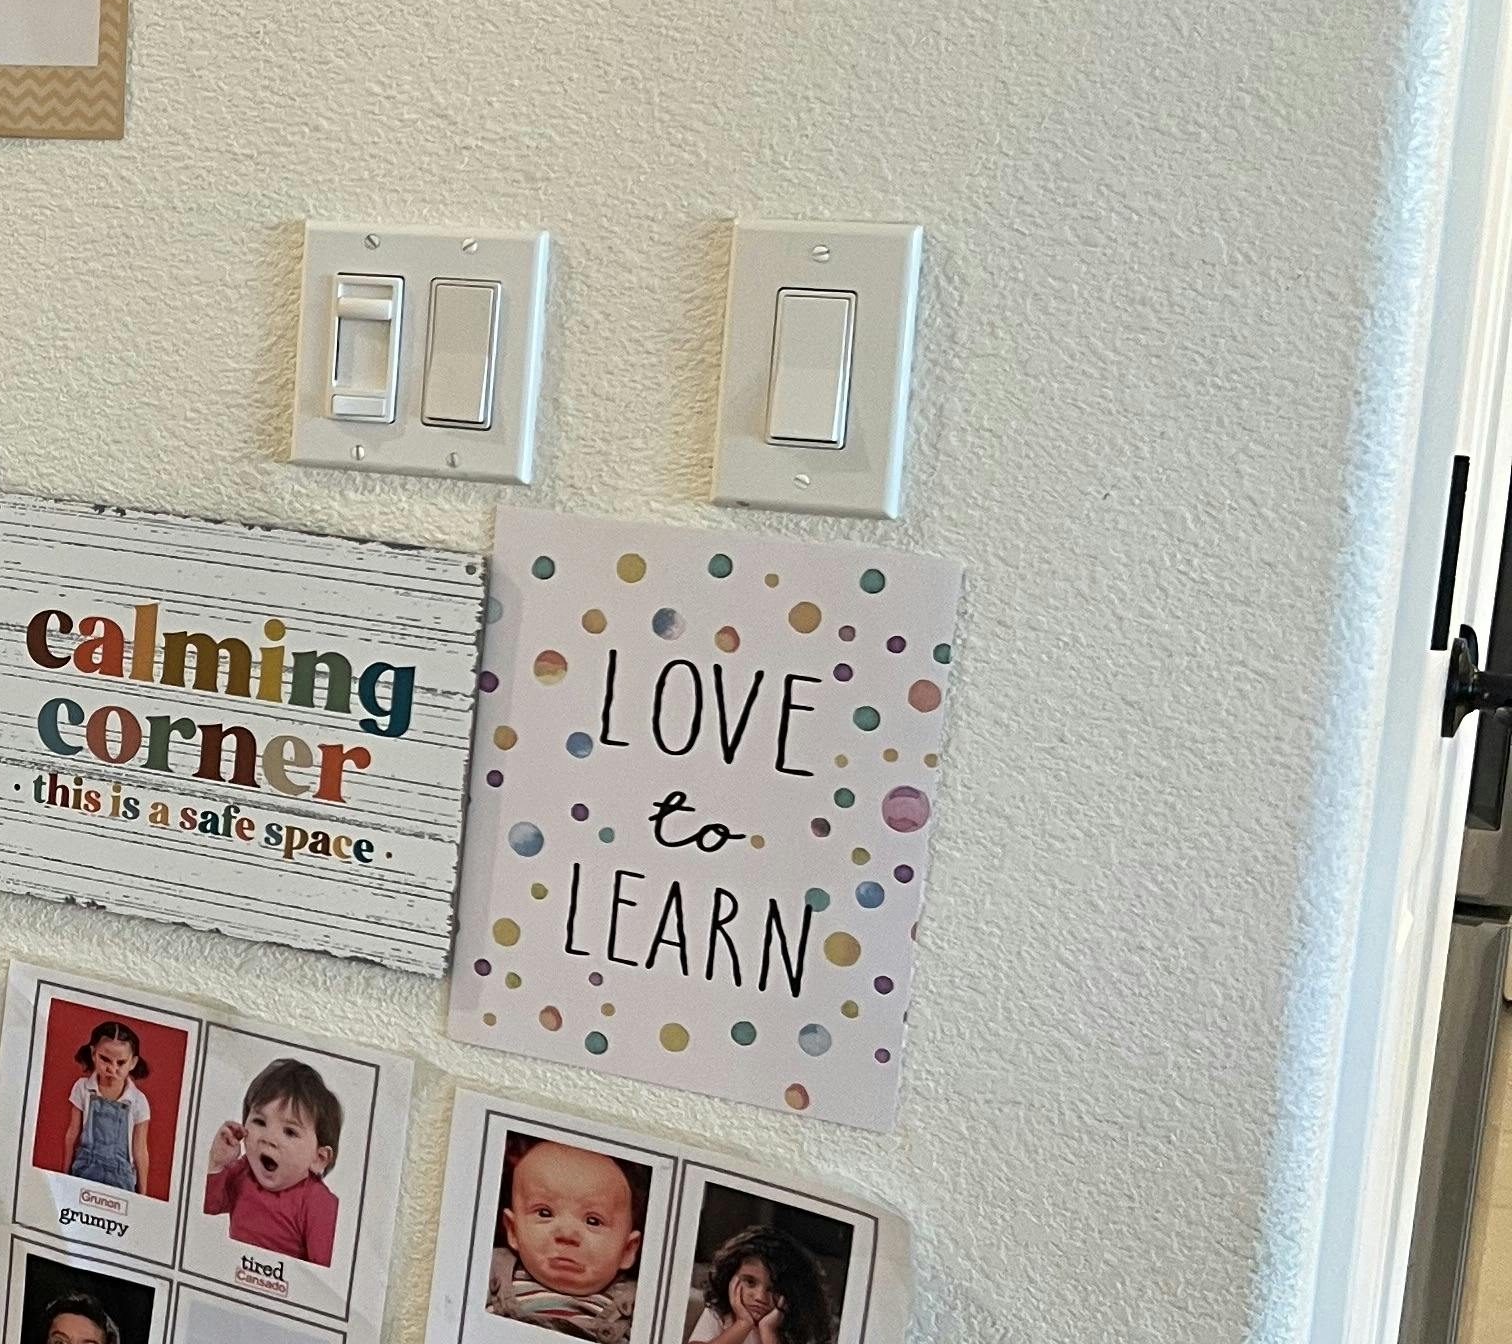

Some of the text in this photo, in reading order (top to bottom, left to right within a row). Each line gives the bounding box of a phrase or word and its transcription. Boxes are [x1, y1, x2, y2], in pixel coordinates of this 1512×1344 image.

[26, 603, 416, 738] calming
[599, 649, 822, 777] LOVE
[37, 697, 372, 804] corner
[32, 773, 374, 863] this is a safe space
[648, 790, 746, 852] to
[564, 862, 814, 998] LEARN
[58, 1207, 130, 1237] grumpy
[236, 1270, 286, 1294] Cansado
[241, 1254, 286, 1283] tired
